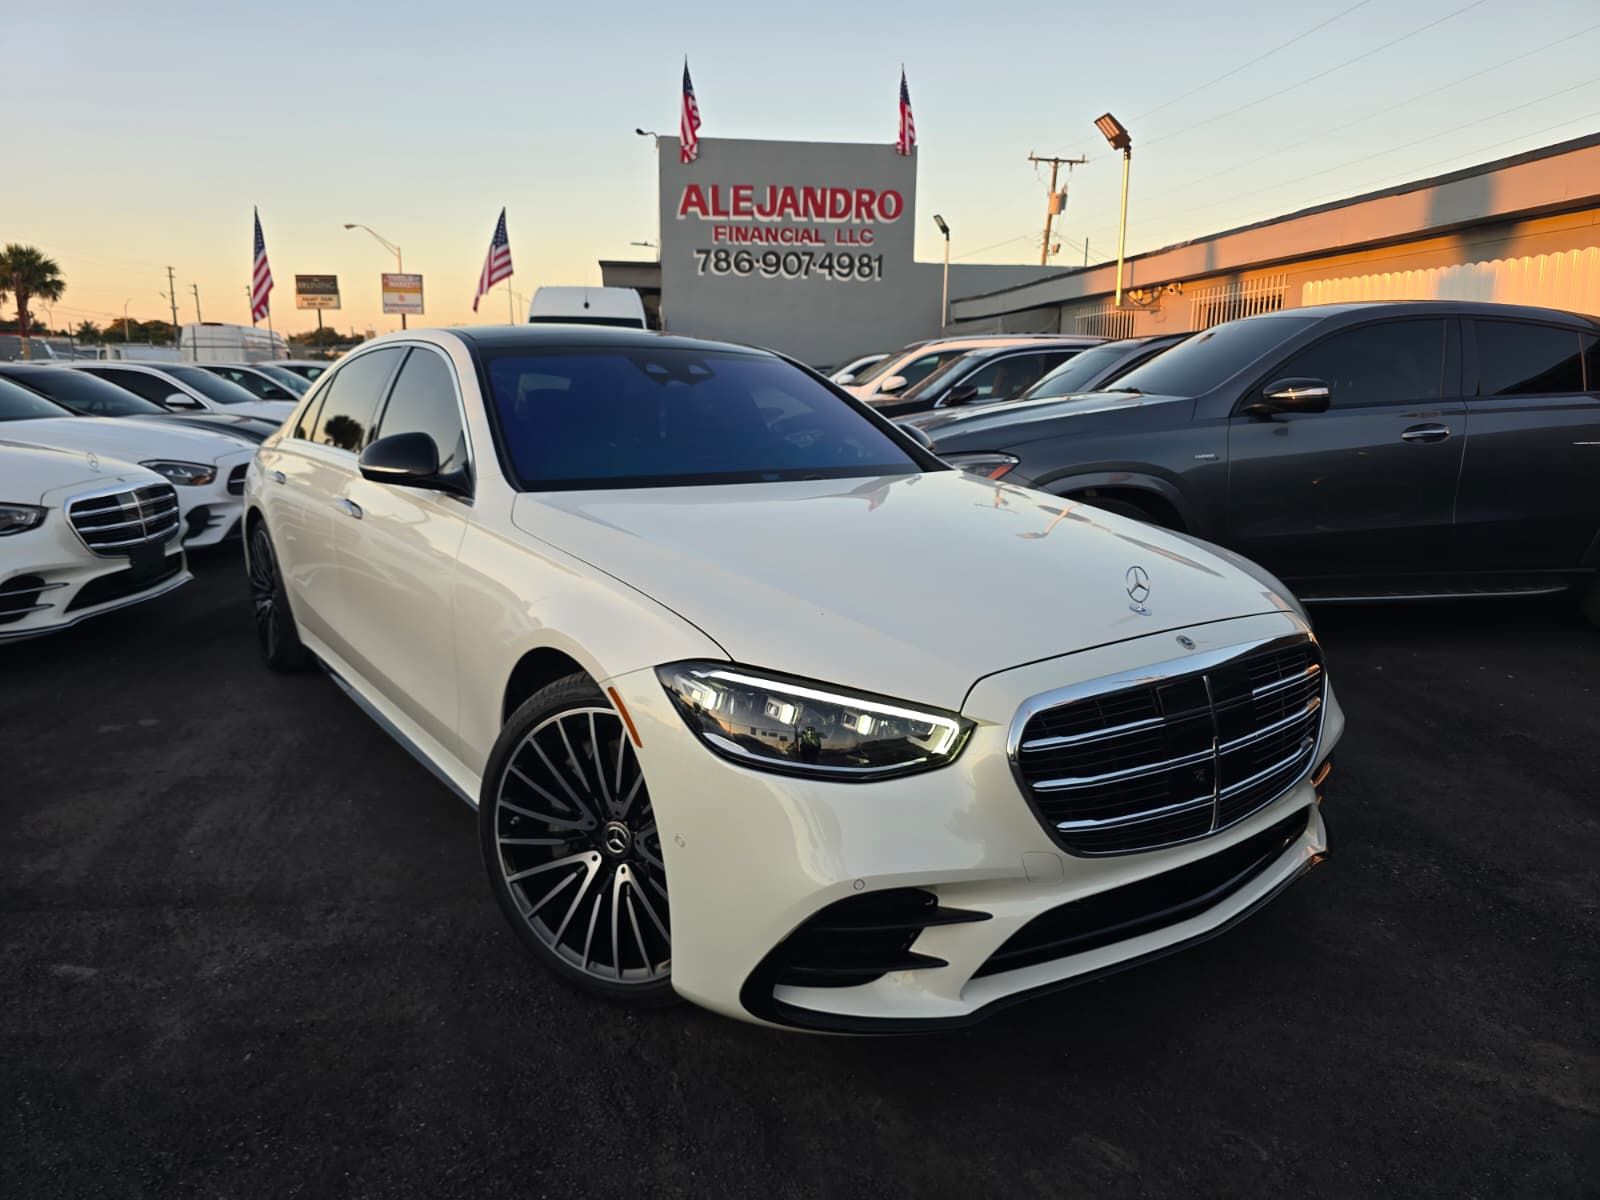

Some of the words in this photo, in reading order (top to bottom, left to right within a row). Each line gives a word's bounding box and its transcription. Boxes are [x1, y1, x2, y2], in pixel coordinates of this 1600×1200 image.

[677, 184, 904, 224] ALEJANDRO
[713, 224, 826, 246] FINANCIAL
[834, 228, 875, 247] LLC
